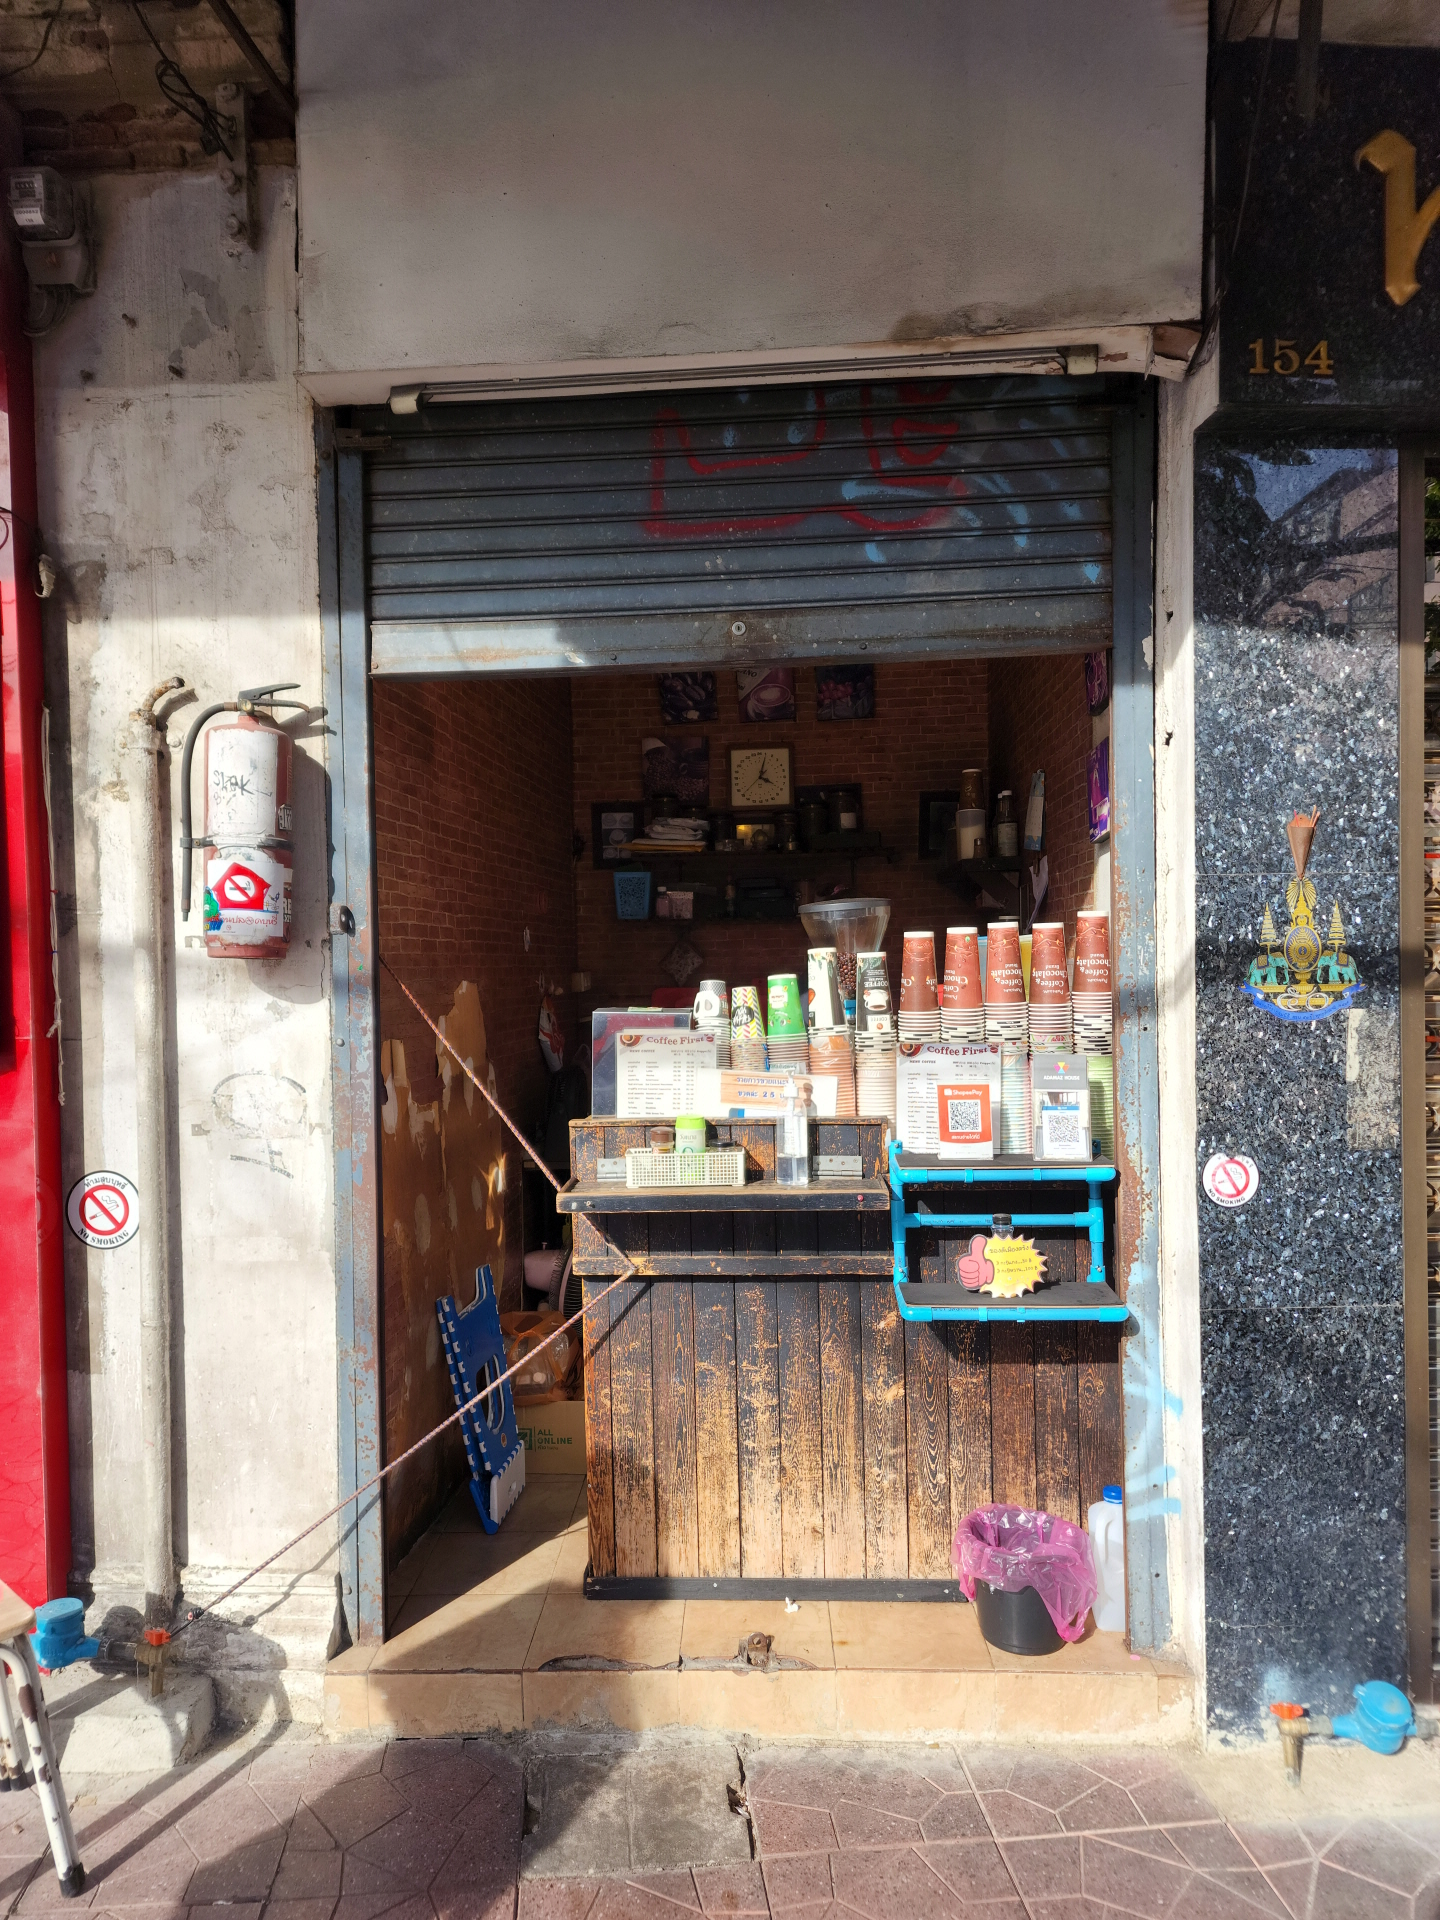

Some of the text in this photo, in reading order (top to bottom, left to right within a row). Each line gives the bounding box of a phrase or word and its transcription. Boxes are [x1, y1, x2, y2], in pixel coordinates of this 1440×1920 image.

[1248, 338, 1334, 376] 154
[647, 1036, 704, 1045] Coffee First
[927, 1046, 988, 1055] Coffee First
[84, 1176, 128, 1189] ห้ามสูบบุหรี่
[1208, 1188, 1245, 1205] NO SMOKING
[78, 1228, 129, 1245] NO SMOKING
